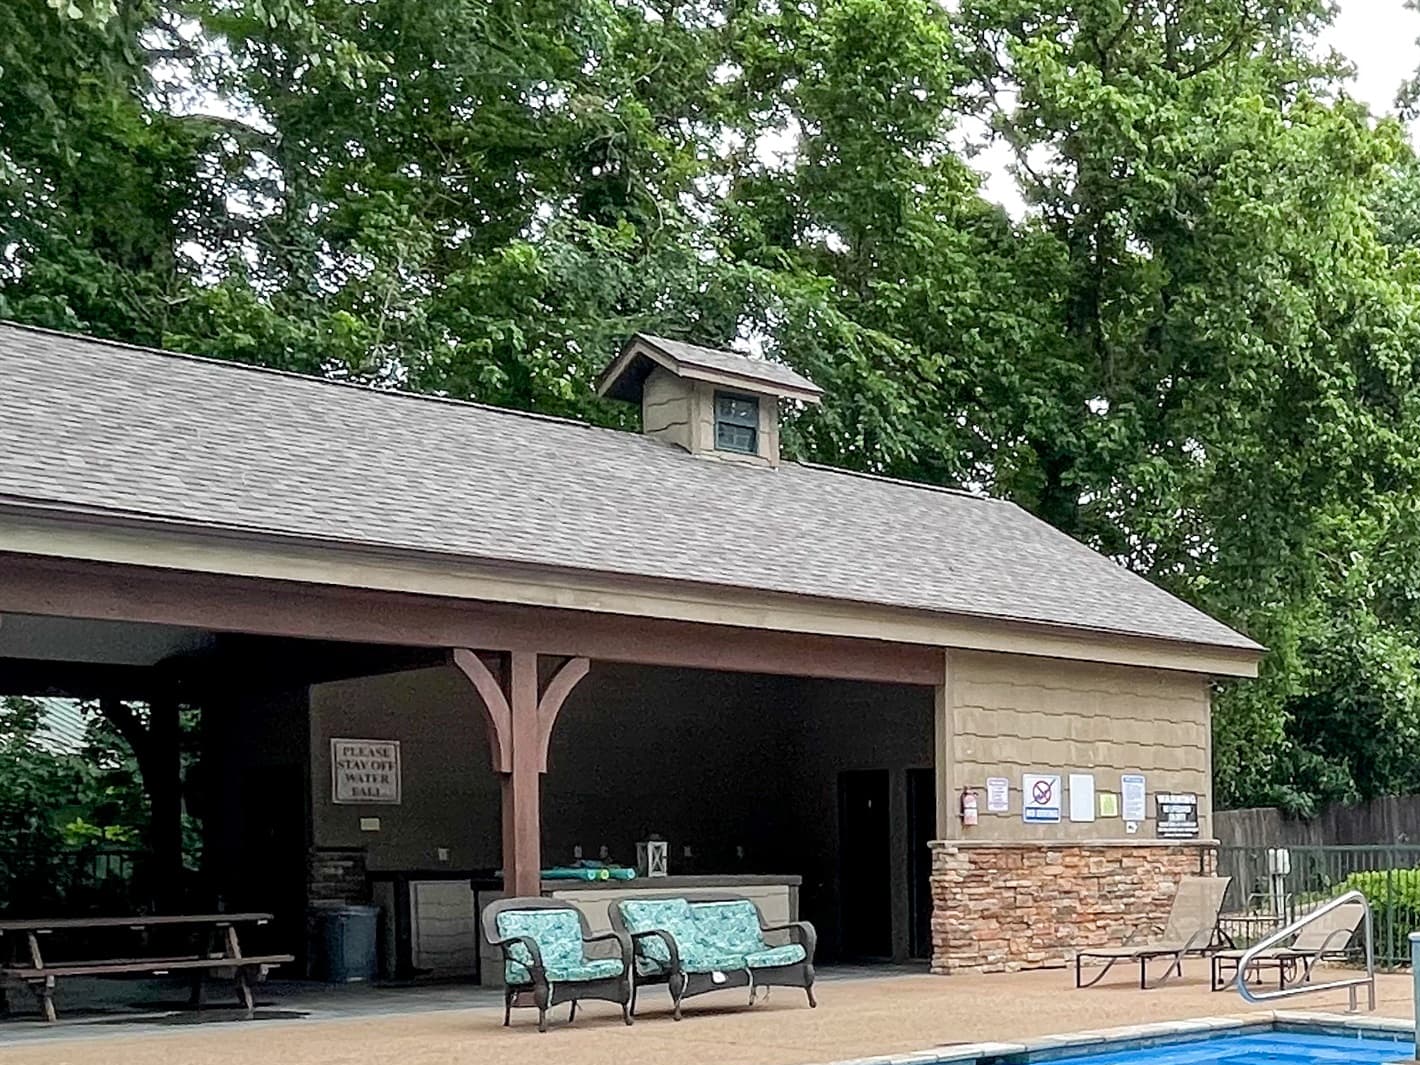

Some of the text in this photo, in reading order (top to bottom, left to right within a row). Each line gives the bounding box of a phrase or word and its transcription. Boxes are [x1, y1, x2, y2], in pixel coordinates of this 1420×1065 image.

[343, 746, 390, 758] PLEASE
[337, 760, 395, 771] STAY OFF
[344, 773, 390, 784] WATER
